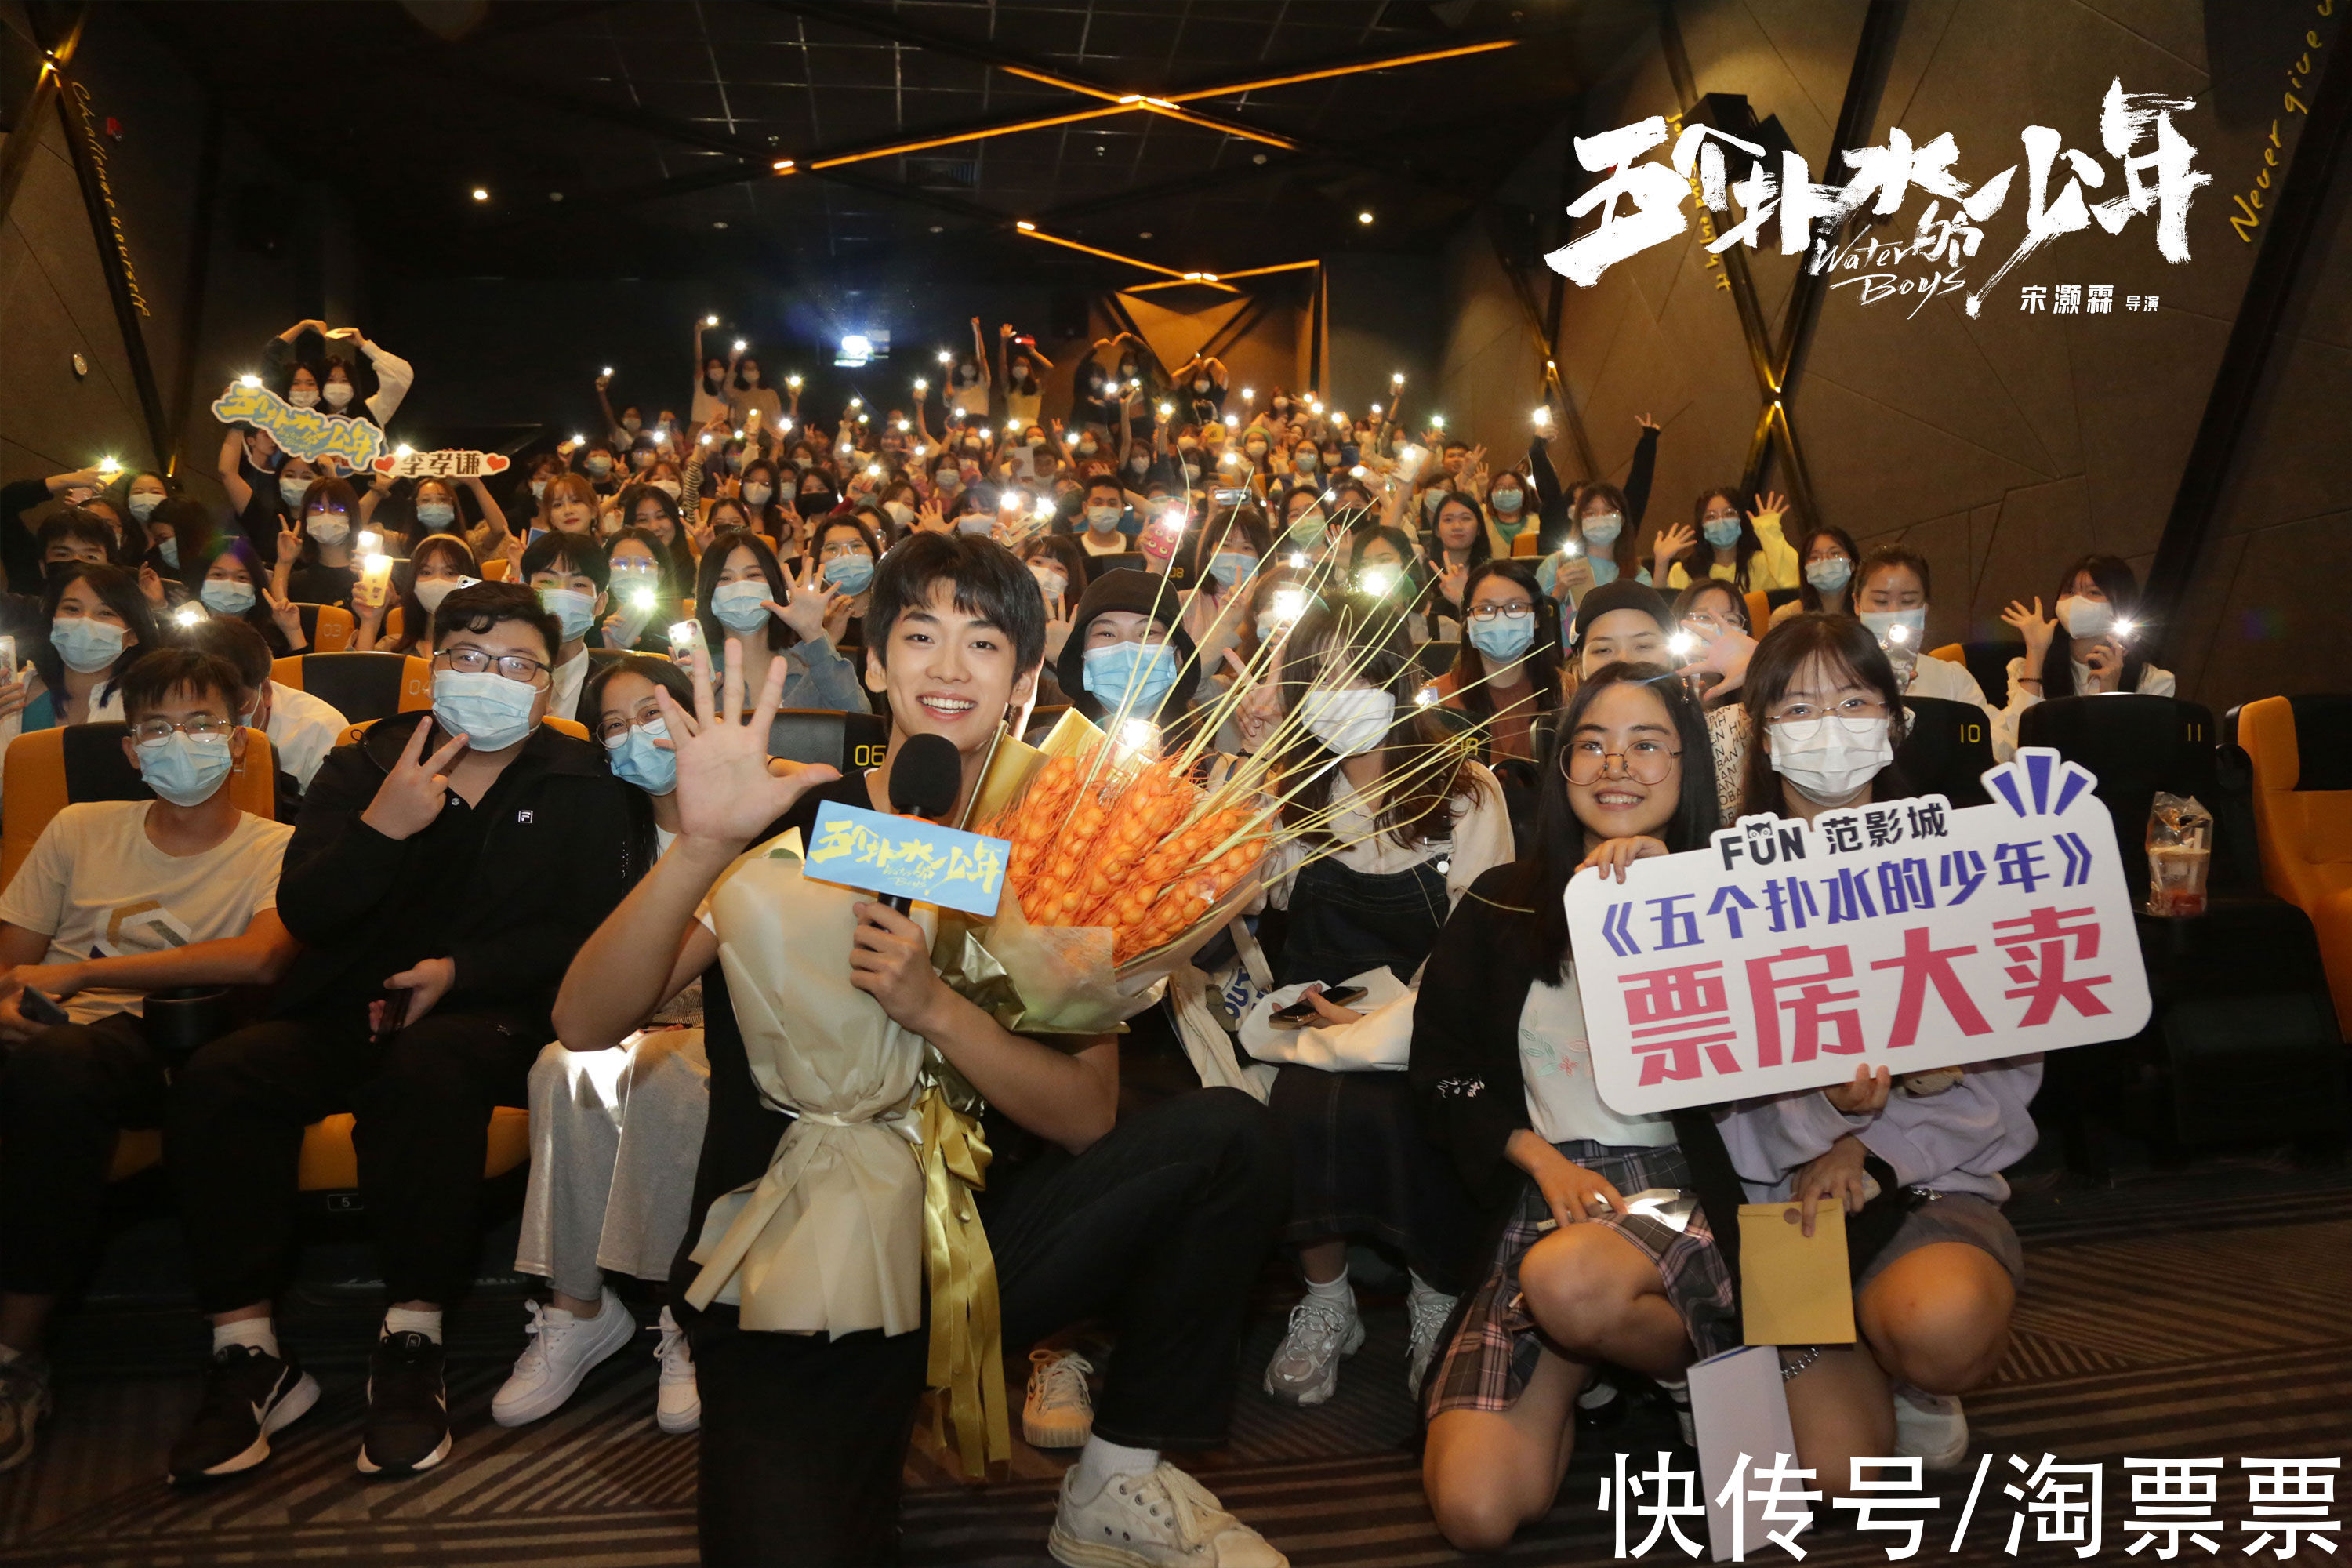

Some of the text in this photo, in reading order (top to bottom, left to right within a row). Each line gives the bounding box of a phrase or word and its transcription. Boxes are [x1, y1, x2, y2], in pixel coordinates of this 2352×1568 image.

[2230, 119, 2283, 243] Never
[2282, 30, 2323, 115] give
[71, 81, 151, 317] Challenge yourself
[1699, 216, 1719, 268] enjy
[401, 452, 481, 476] 李孝谦
[323, 623, 342, 637] 03
[1960, 724, 1980, 743] 10
[2187, 723, 2201, 742] 11
[855, 745, 887, 766] 06
[1719, 801, 1949, 870] FUN 范影城
[1617, 906, 2113, 1087] 票房大卖
[341, 1196, 351, 1208] 5
